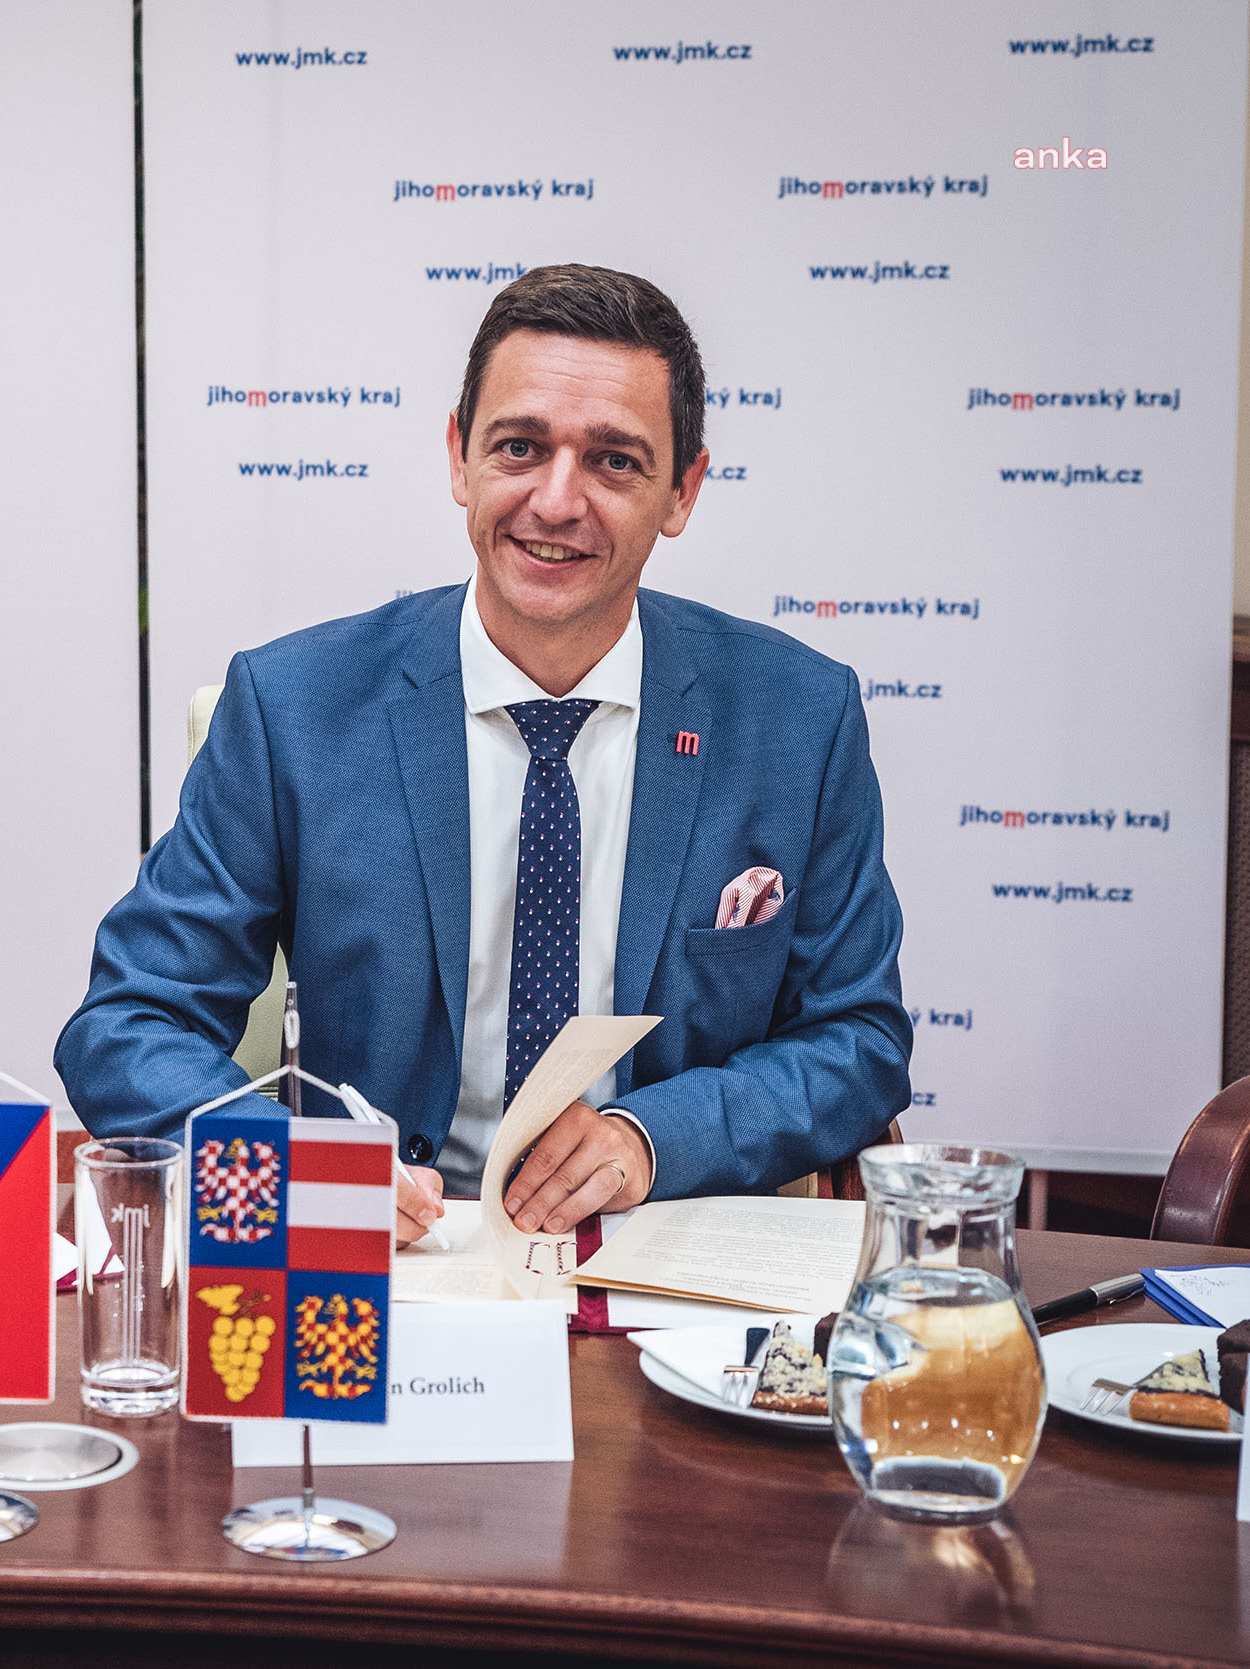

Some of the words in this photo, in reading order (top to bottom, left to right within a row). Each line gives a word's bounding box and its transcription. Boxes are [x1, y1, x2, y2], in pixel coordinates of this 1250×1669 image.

[614, 42, 751, 64] www.jmk.cz
[1009, 34, 1154, 57] www.jmk.cz
[236, 48, 367, 69] www.jmk.cz
[394, 180, 542, 202] jihomoravský
[552, 179, 593, 200] kraj
[779, 176, 935, 198] jihomoravský
[944, 176, 987, 197] kraj
[810, 261, 949, 283] www.jmk.cz
[207, 386, 351, 407] jihomoravský
[361, 388, 400, 407] kraj
[740, 389, 781, 409] kraj
[968, 389, 1126, 410] jihomoravský
[1136, 389, 1180, 410] kraj
[239, 460, 368, 480] www.jmk.cz
[1000, 465, 1142, 487] www.jmk.cz
[774, 596, 927, 618] jihomoravský
[936, 599, 979, 619] kraj
[960, 806, 1116, 830] jihomoravský
[1125, 811, 1169, 832] kraj
[993, 883, 1132, 903] www.jmk.cz
[930, 1009, 972, 1030] kraj
[410, 1377, 484, 1394] Grolich
